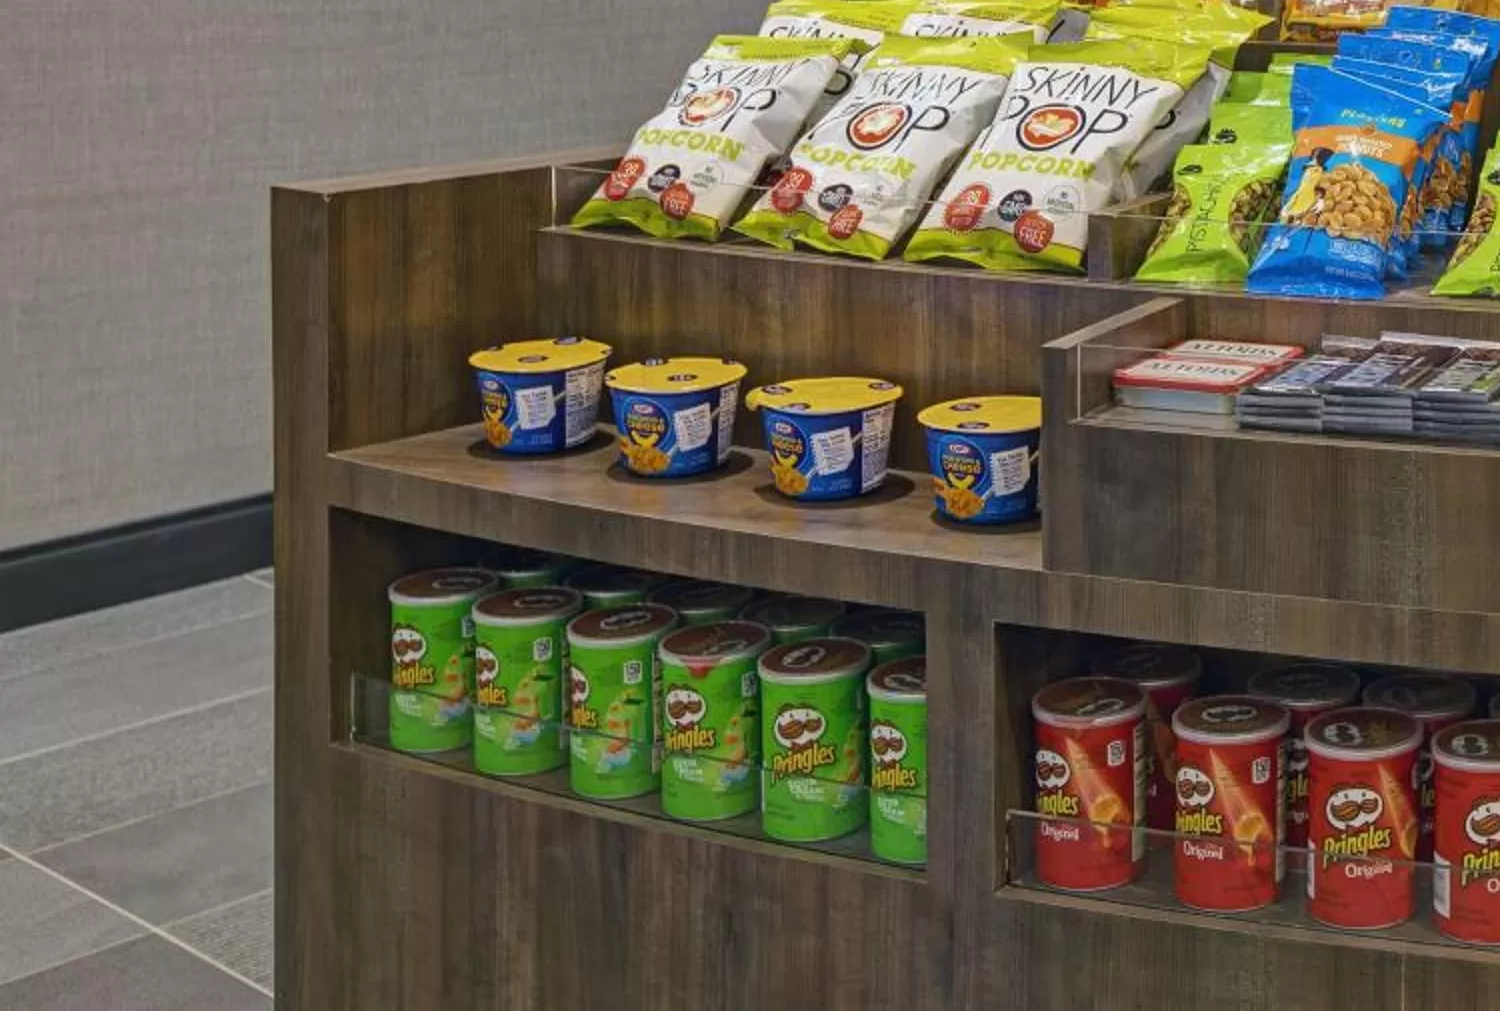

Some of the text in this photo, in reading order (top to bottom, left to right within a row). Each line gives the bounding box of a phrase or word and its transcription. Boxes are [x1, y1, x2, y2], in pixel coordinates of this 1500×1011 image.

[690, 57, 812, 87] SKINNY
[868, 69, 981, 105] SKINNY
[1024, 66, 1161, 109] SKINNY
[639, 128, 746, 163] POPCORN
[970, 151, 1098, 183] POPCORN
[1019, 225, 1050, 249] FREE
[666, 726, 716, 752] ringles
[771, 743, 836, 780] Pringles
[872, 763, 917, 789] ingles
[1323, 826, 1393, 870] Pringles
